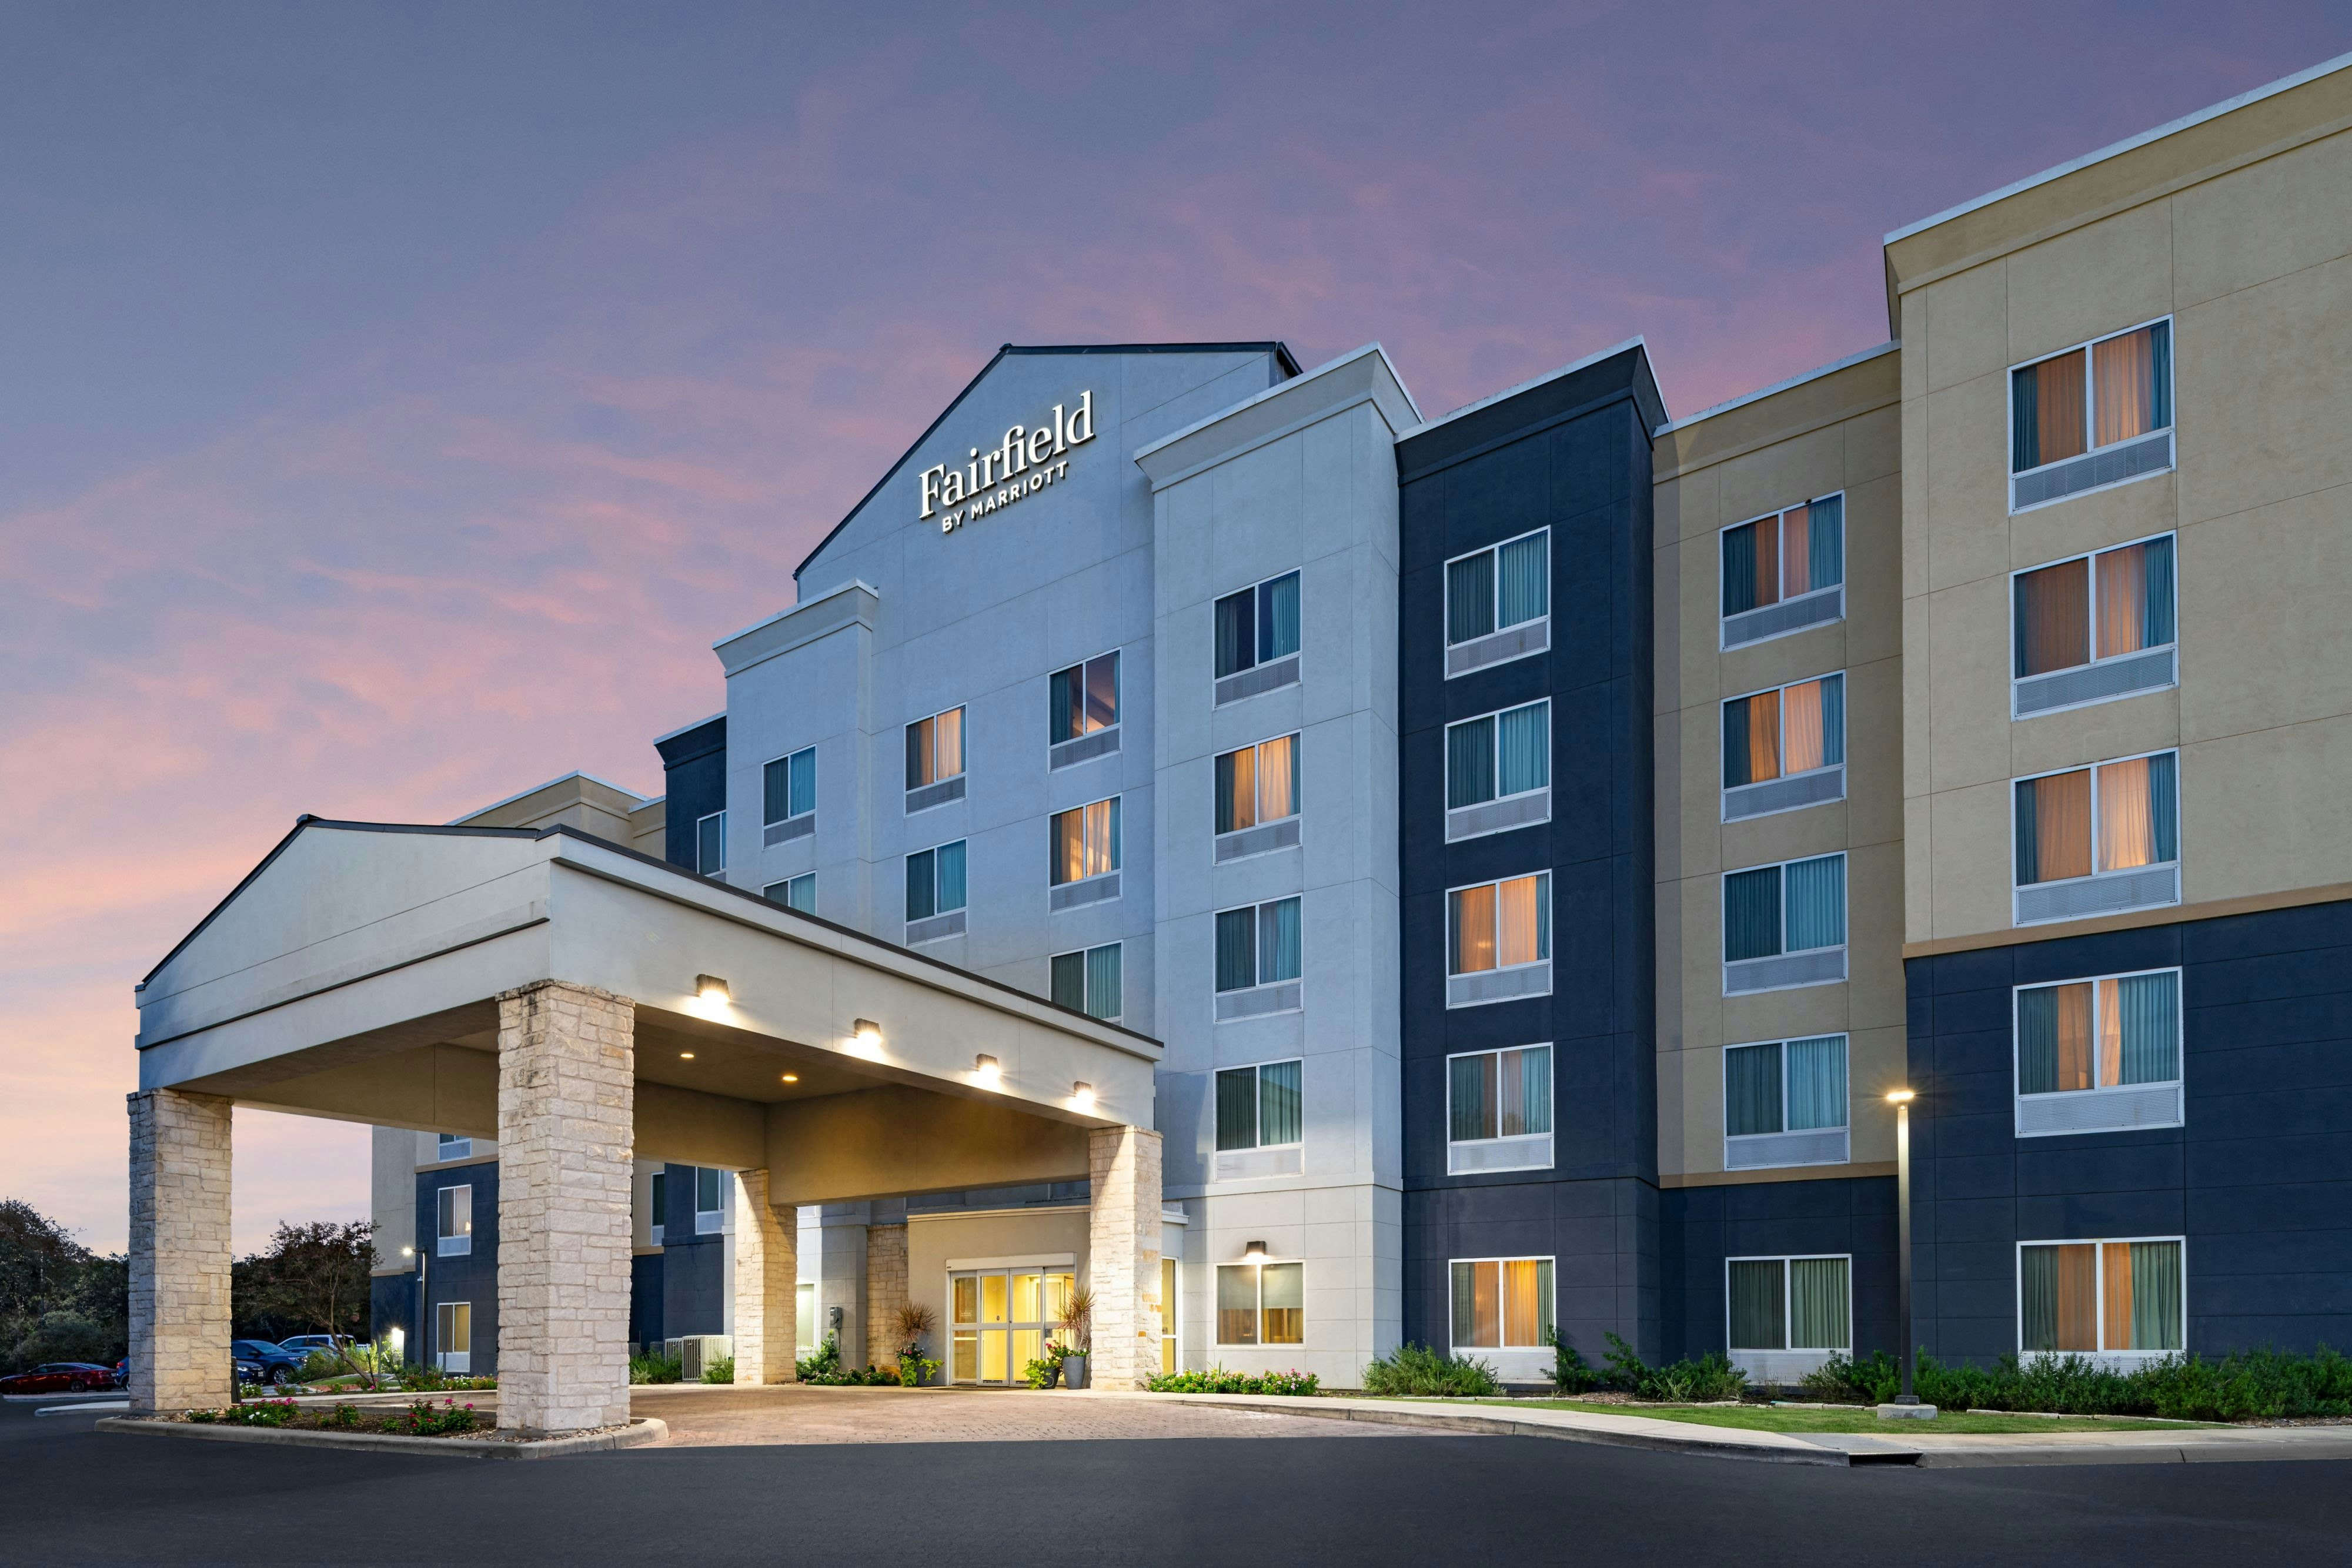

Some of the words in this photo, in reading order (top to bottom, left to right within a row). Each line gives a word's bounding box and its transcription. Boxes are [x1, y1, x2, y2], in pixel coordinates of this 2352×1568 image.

[918, 390, 1095, 519] Fairfield
[943, 509, 965, 533] BY
[971, 460, 1069, 520] MARRIOTT
